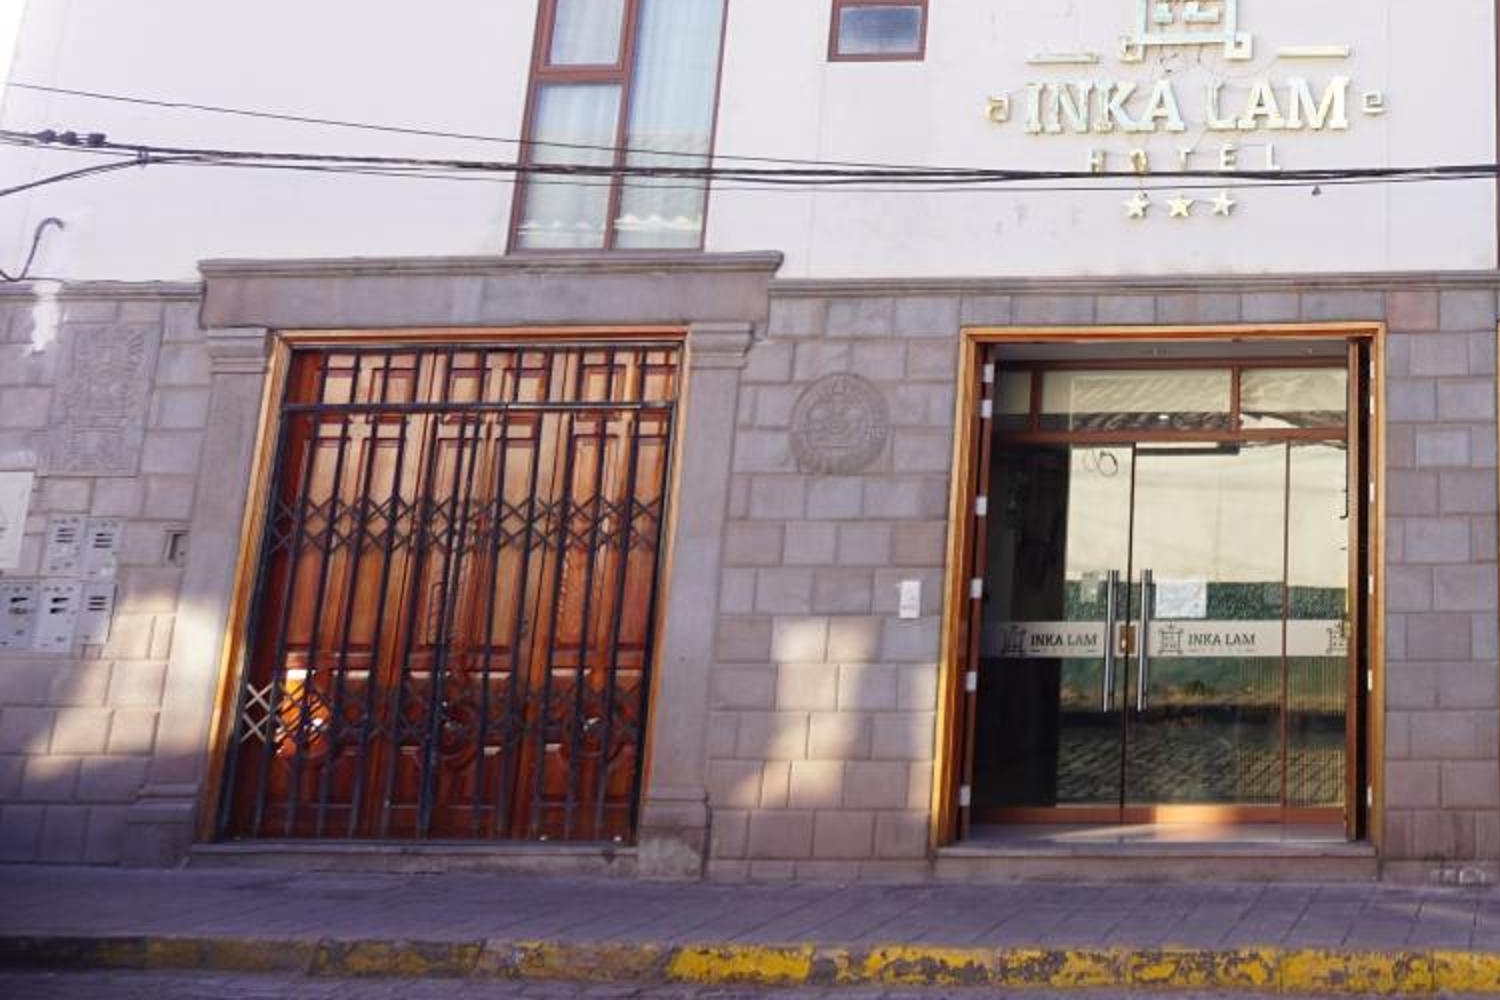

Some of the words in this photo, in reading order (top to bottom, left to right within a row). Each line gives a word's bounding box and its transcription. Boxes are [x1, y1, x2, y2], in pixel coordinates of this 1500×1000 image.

[1023, 78, 1185, 134] INKA
[1204, 75, 1352, 130] LAM
[1088, 142, 1281, 173] HOTEL
[1030, 633, 1063, 647] INKA
[1067, 633, 1097, 646] LAM
[1187, 633, 1221, 647] INKA
[1225, 632, 1256, 646] LAM
